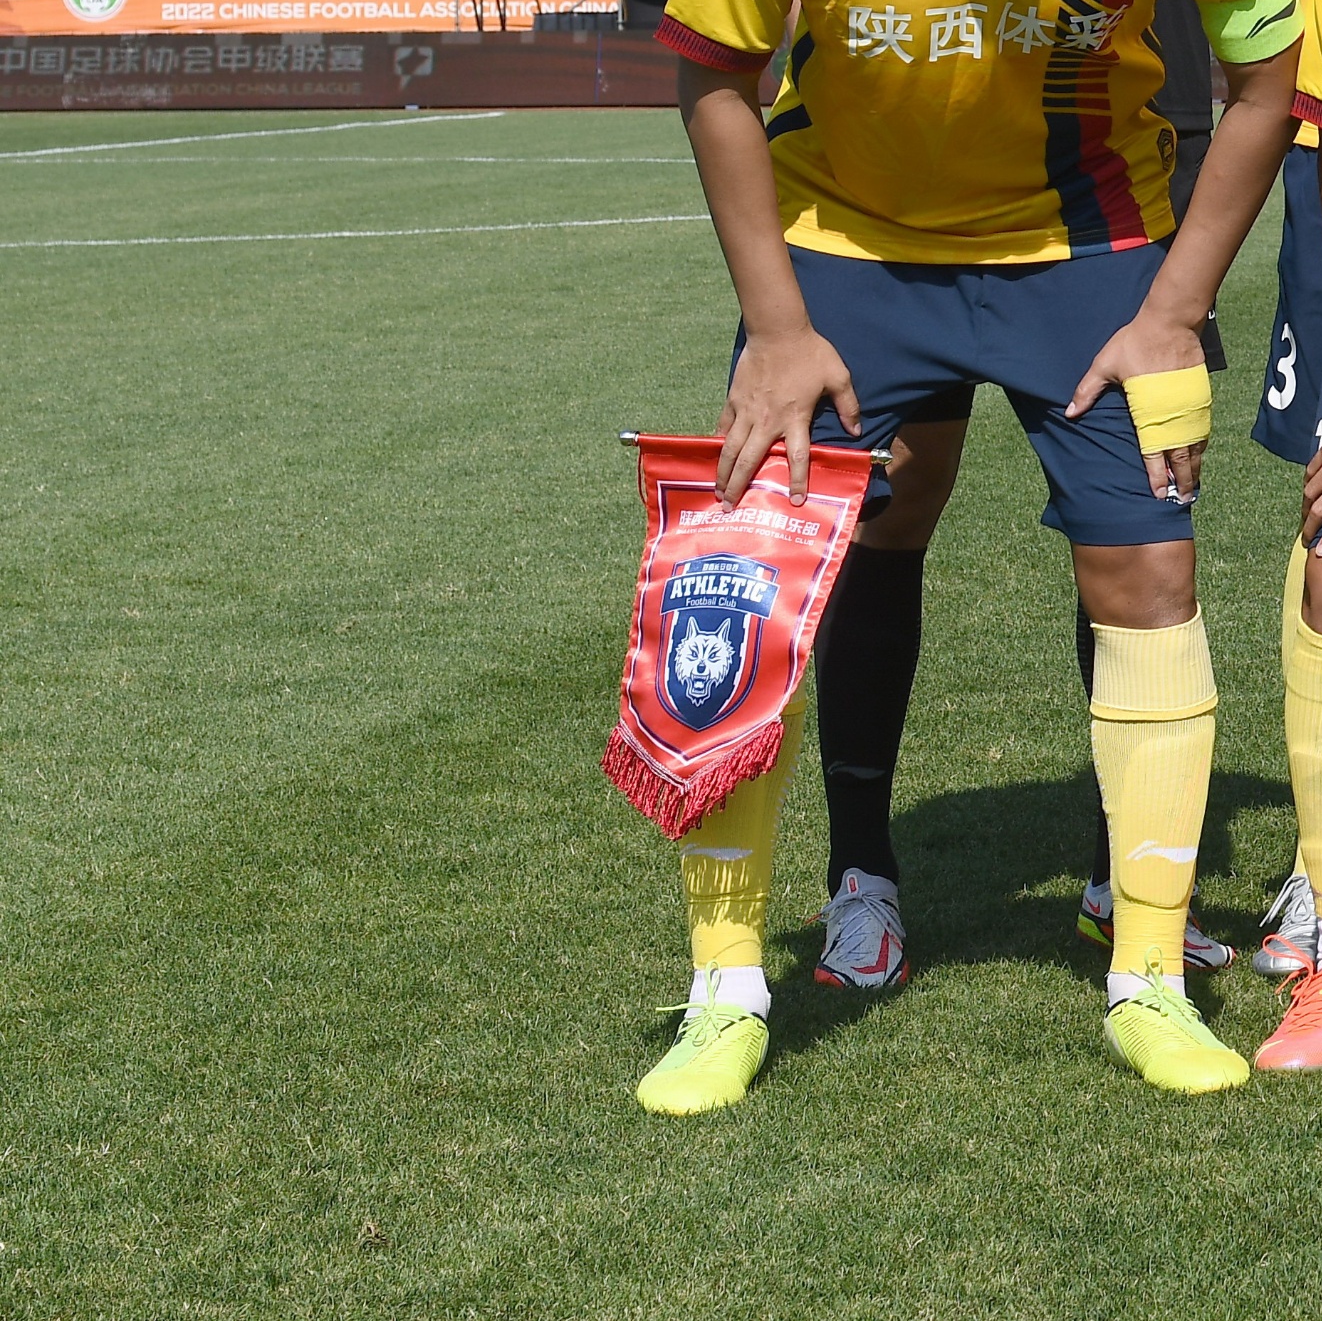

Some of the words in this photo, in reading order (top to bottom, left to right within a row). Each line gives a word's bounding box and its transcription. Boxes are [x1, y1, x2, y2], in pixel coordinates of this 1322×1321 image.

[161, 3, 214, 21] 2022
[219, 3, 305, 19] CHINESE
[310, 1, 414, 19] FOOTBALL
[847, 2, 1129, 64] 陕西体彩
[1267, 321, 1297, 411] 3
[755, 528, 792, 542] FOOTBALL
[795, 537, 815, 546] CLUB
[670, 575, 769, 603] ATHLETIC
[686, 597, 717, 607] Football
[718, 597, 737, 608] Club
